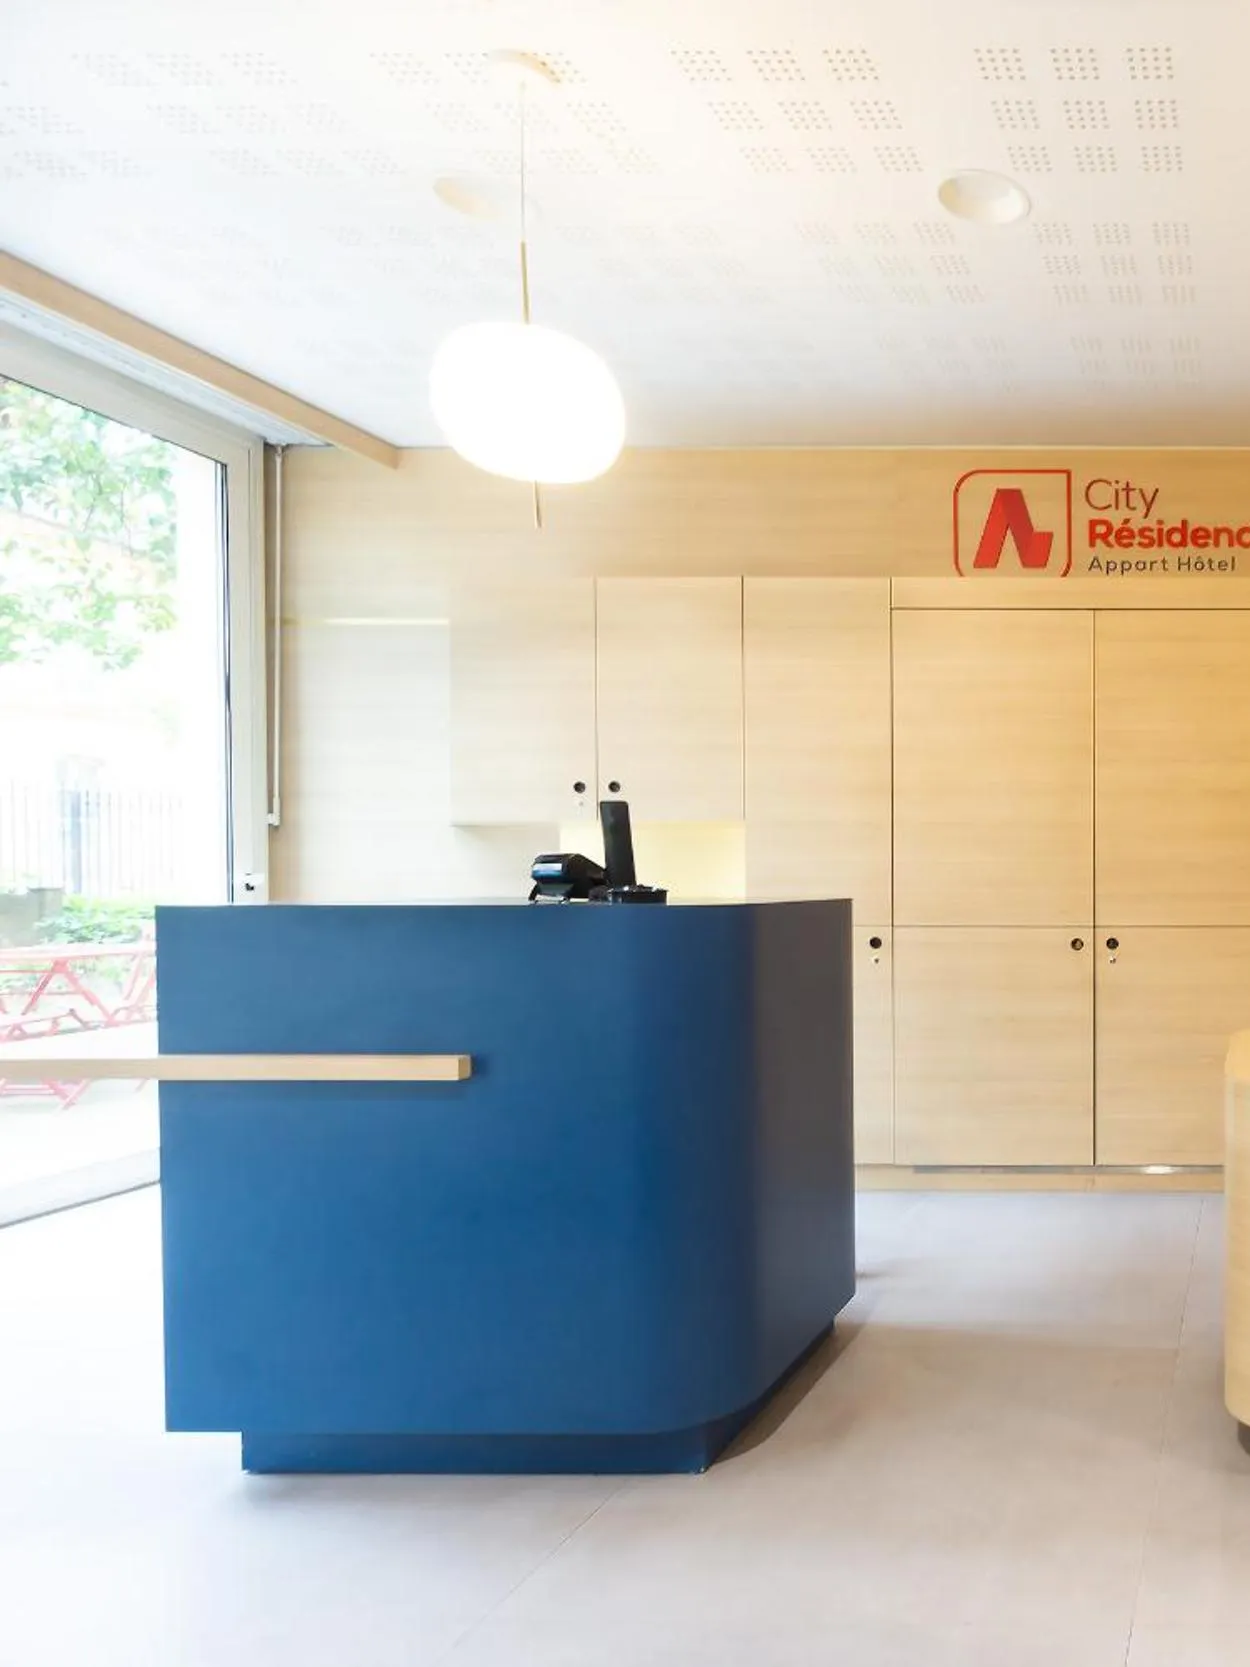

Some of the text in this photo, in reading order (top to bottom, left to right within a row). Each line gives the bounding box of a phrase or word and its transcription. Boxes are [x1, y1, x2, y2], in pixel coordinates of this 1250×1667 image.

[1084, 478, 1160, 519] City
[1088, 555, 1236, 576] Appart Hôtel
